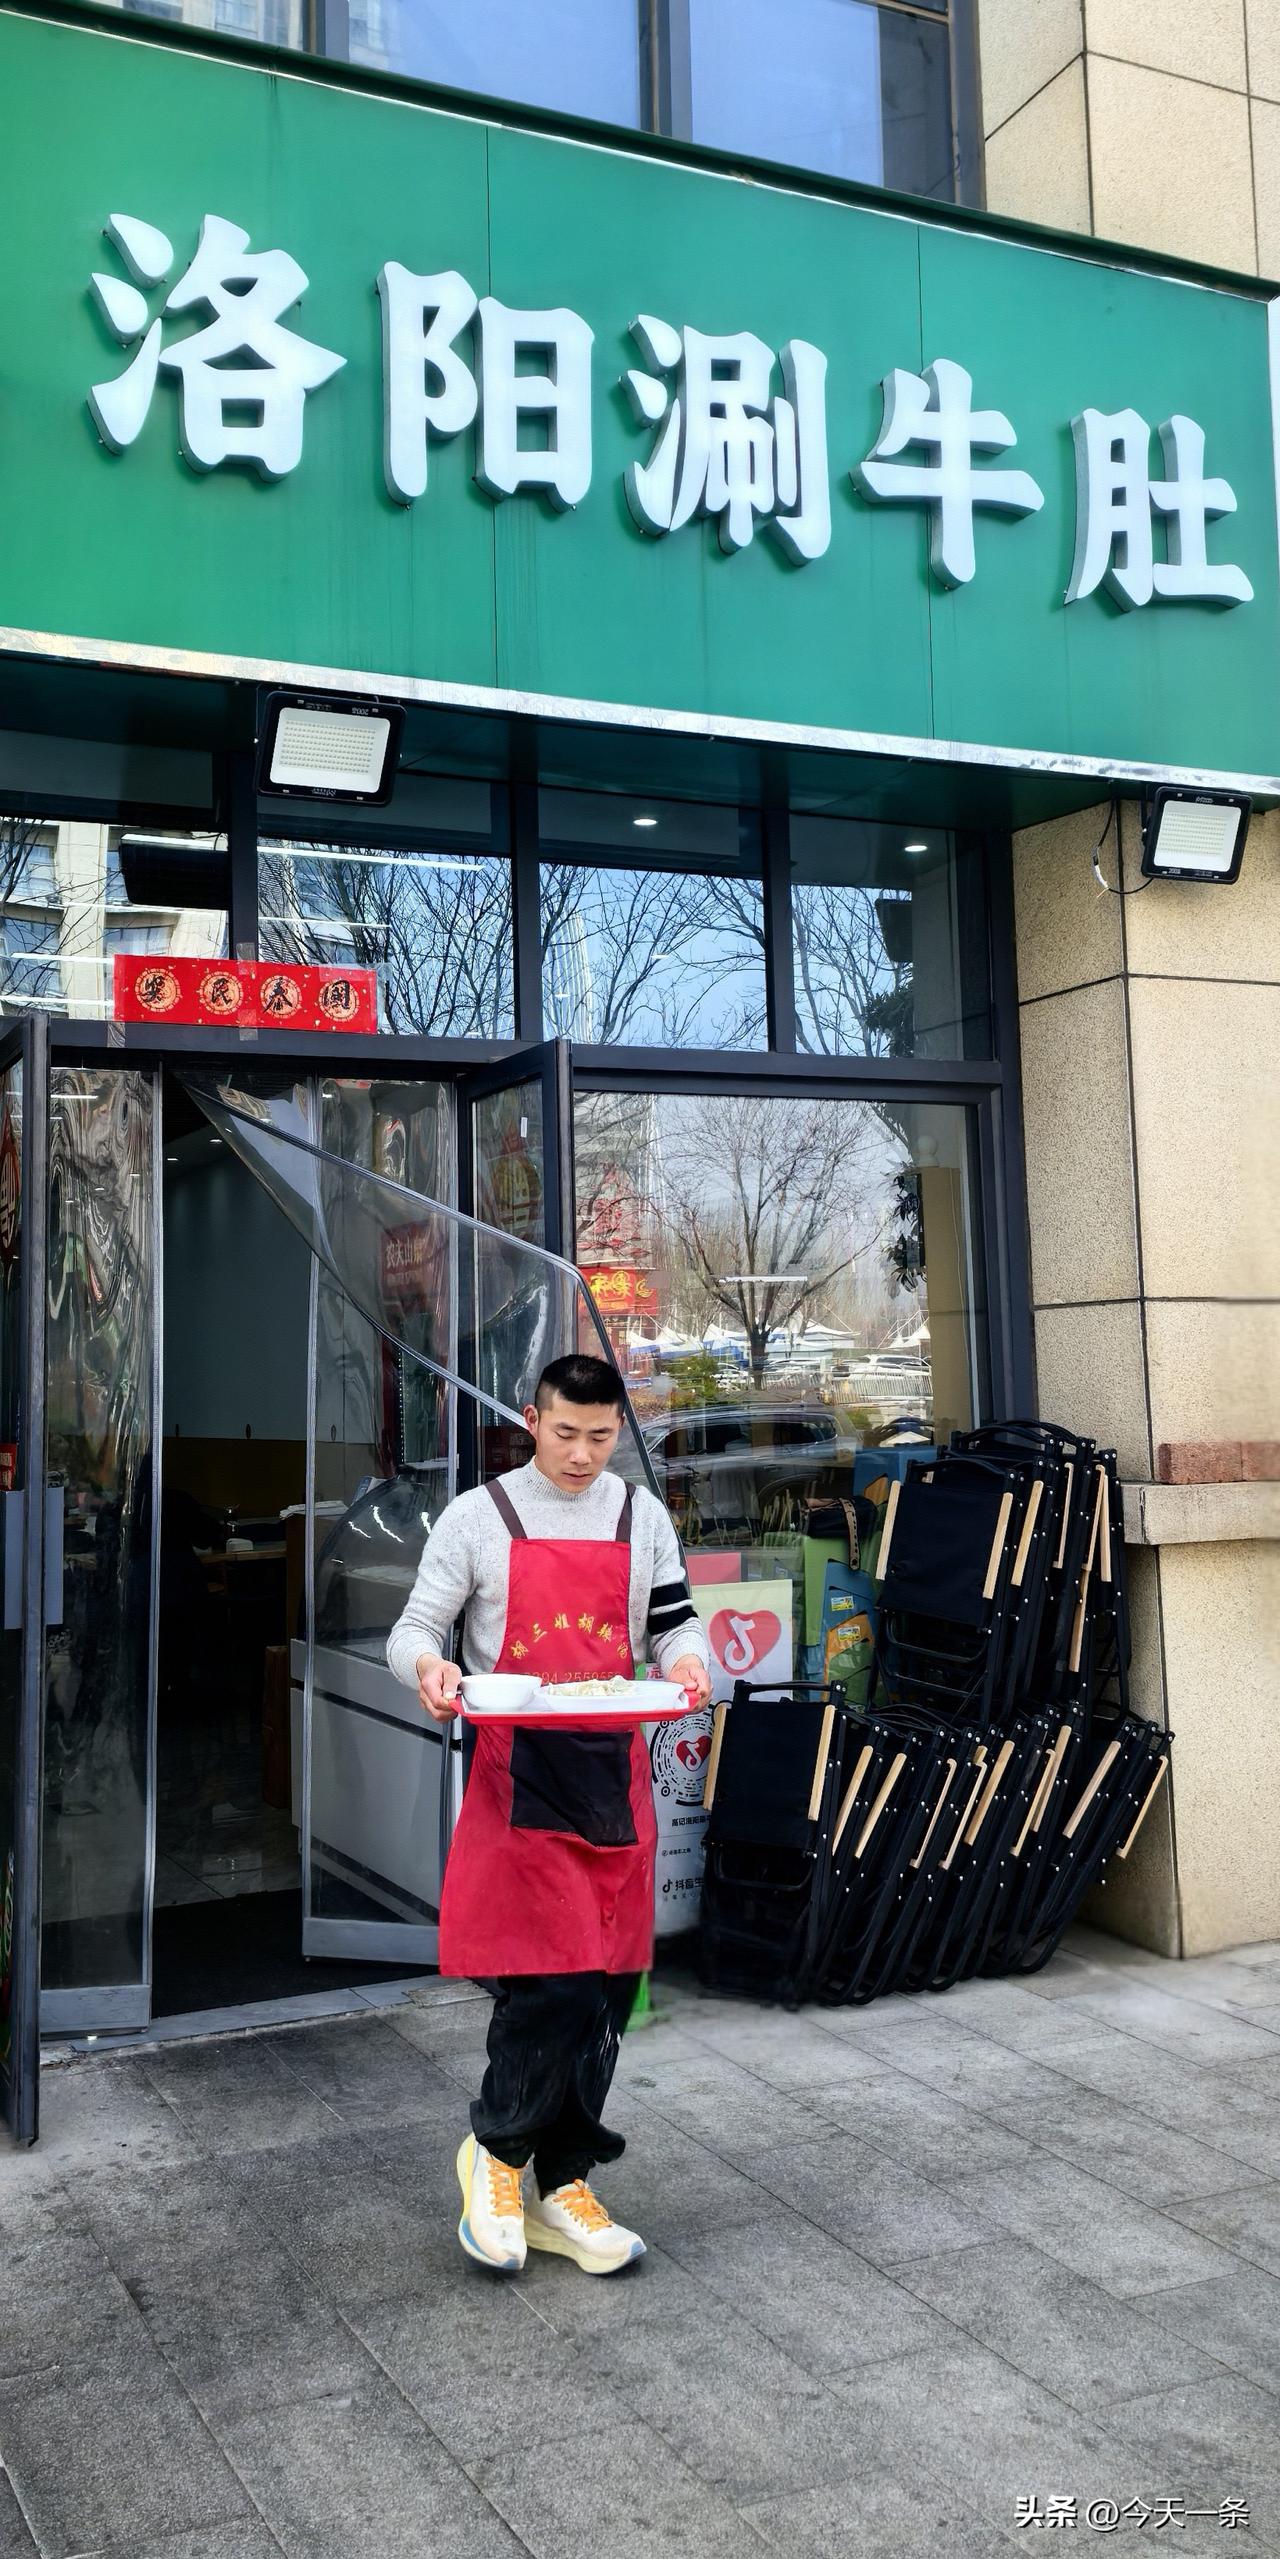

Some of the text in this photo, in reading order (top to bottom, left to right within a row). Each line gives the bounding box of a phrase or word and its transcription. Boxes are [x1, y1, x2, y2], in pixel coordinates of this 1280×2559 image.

[88, 213, 1255, 612] 洛阳涮牛肚
